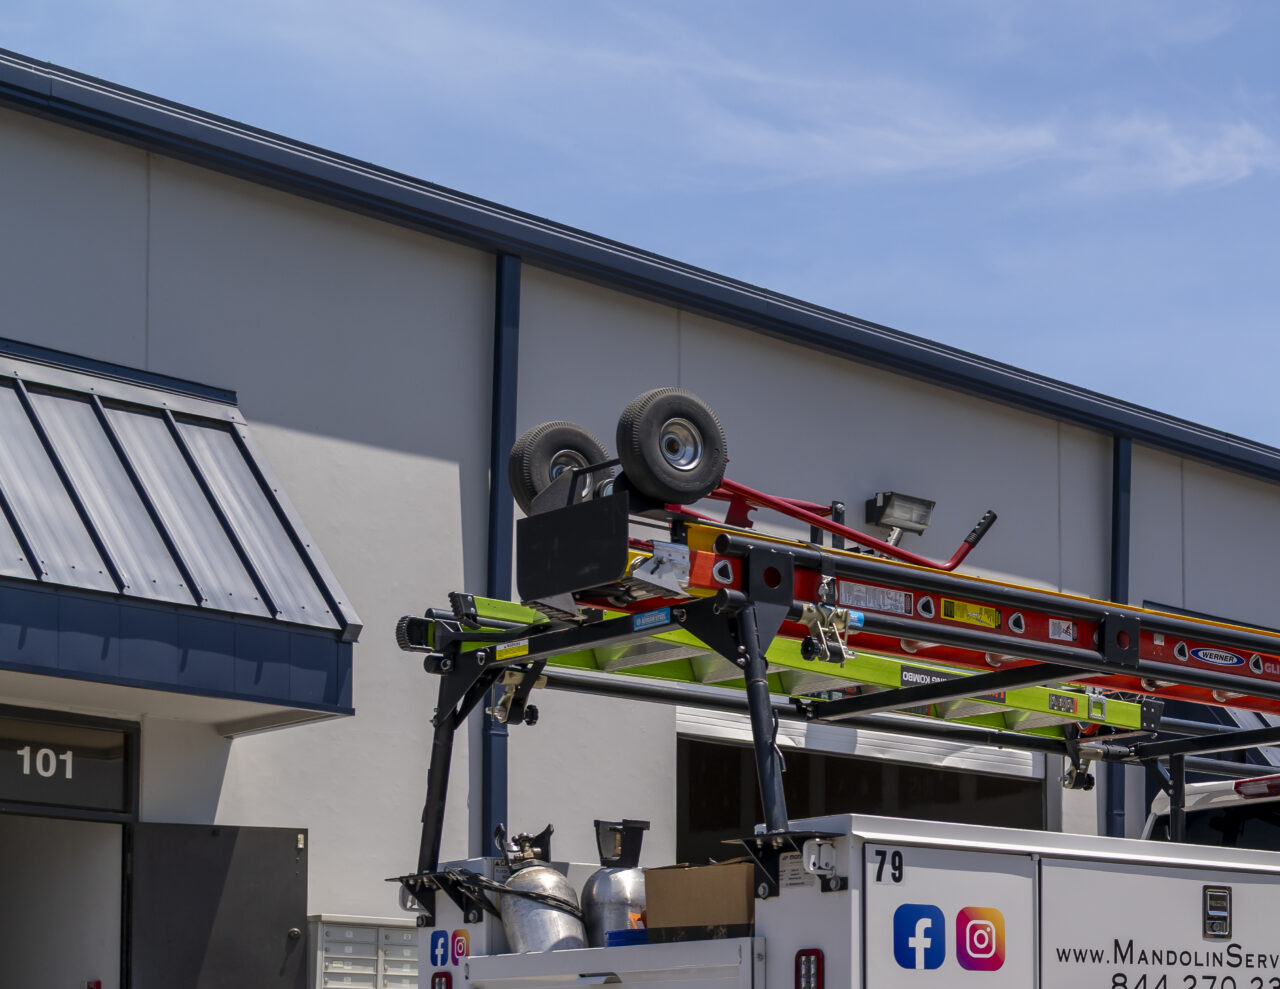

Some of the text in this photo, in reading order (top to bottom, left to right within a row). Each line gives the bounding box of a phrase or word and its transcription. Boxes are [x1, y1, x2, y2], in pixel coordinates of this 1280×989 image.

[1202, 651, 1235, 663] WERNER
[902, 671, 931, 684] KOMBO
[16, 746, 73, 779] 101
[874, 849, 904, 883] 79
